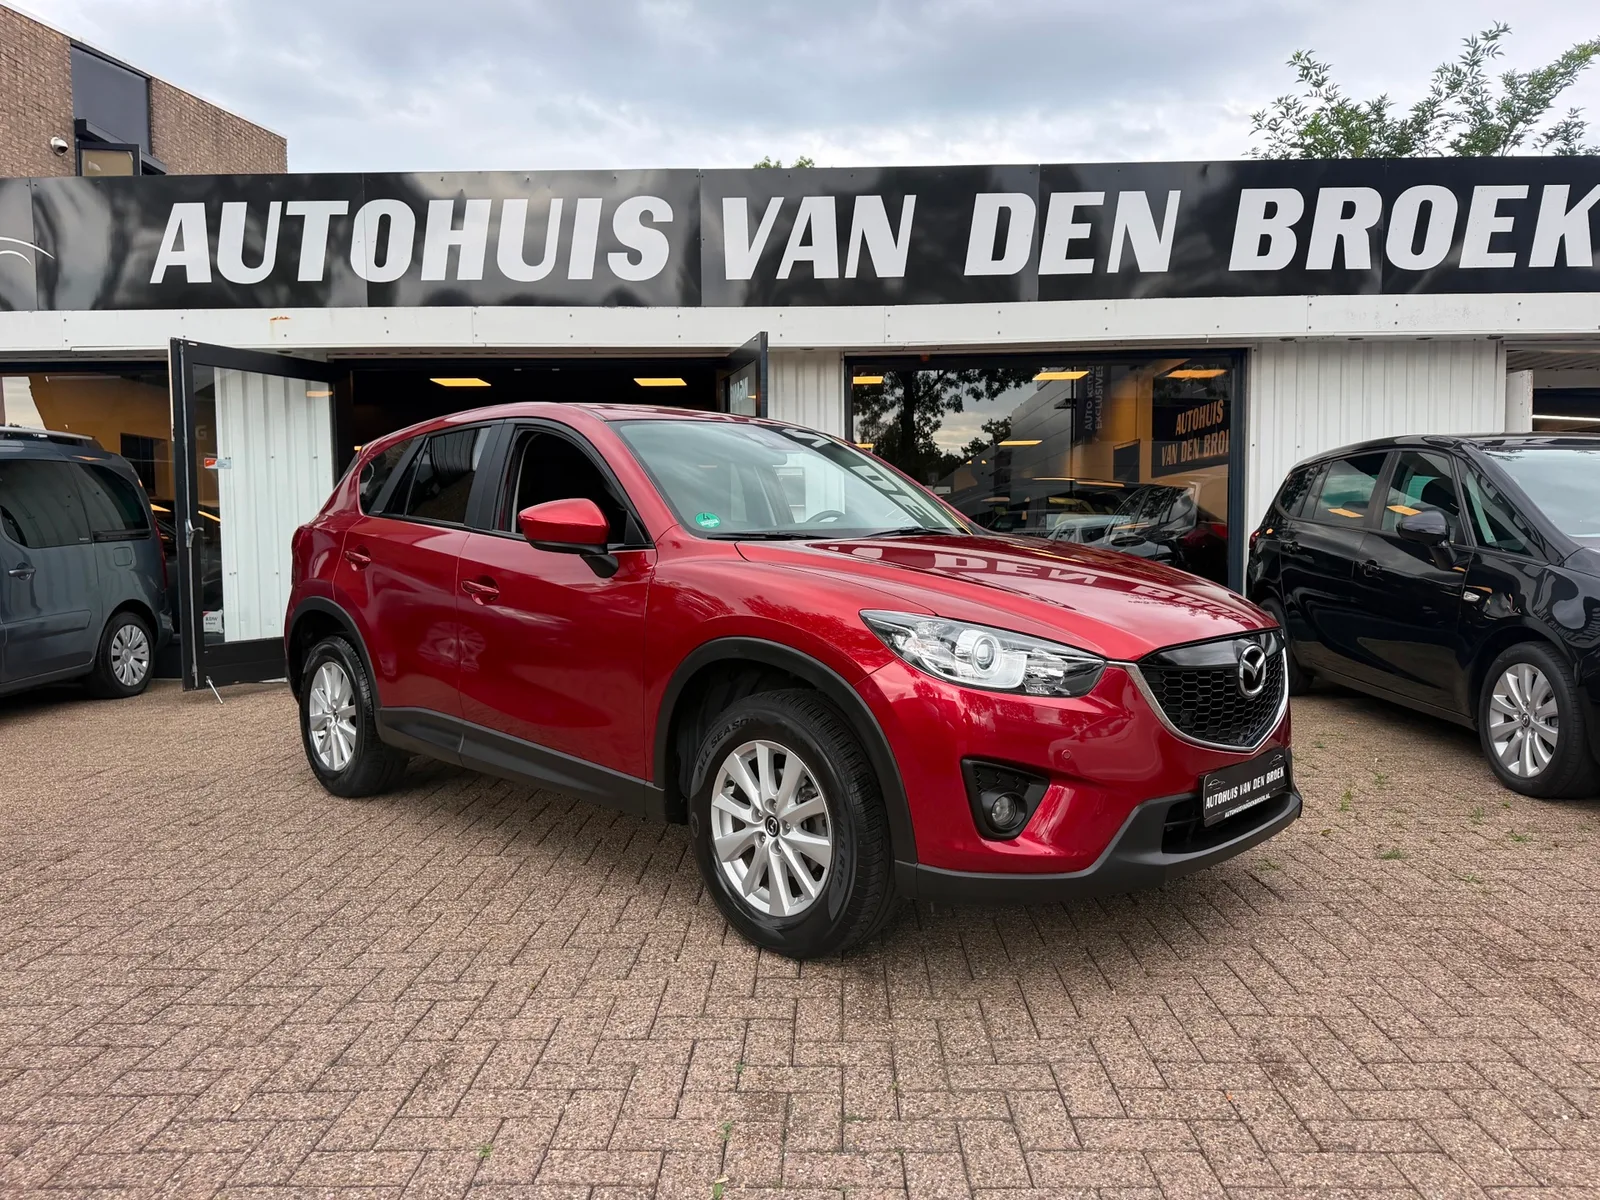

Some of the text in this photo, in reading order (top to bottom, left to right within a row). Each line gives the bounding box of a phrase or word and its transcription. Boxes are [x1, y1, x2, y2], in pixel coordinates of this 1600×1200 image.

[150, 185, 1600, 284] AUTOHUIS VAN DEN BROEK
[1175, 400, 1224, 436] AUTOHUIS
[1162, 441, 1177, 466] VAN
[1180, 435, 1199, 463] DEN
[1205, 766, 1285, 810] AUTOHUIS VAN DEN BROEK
